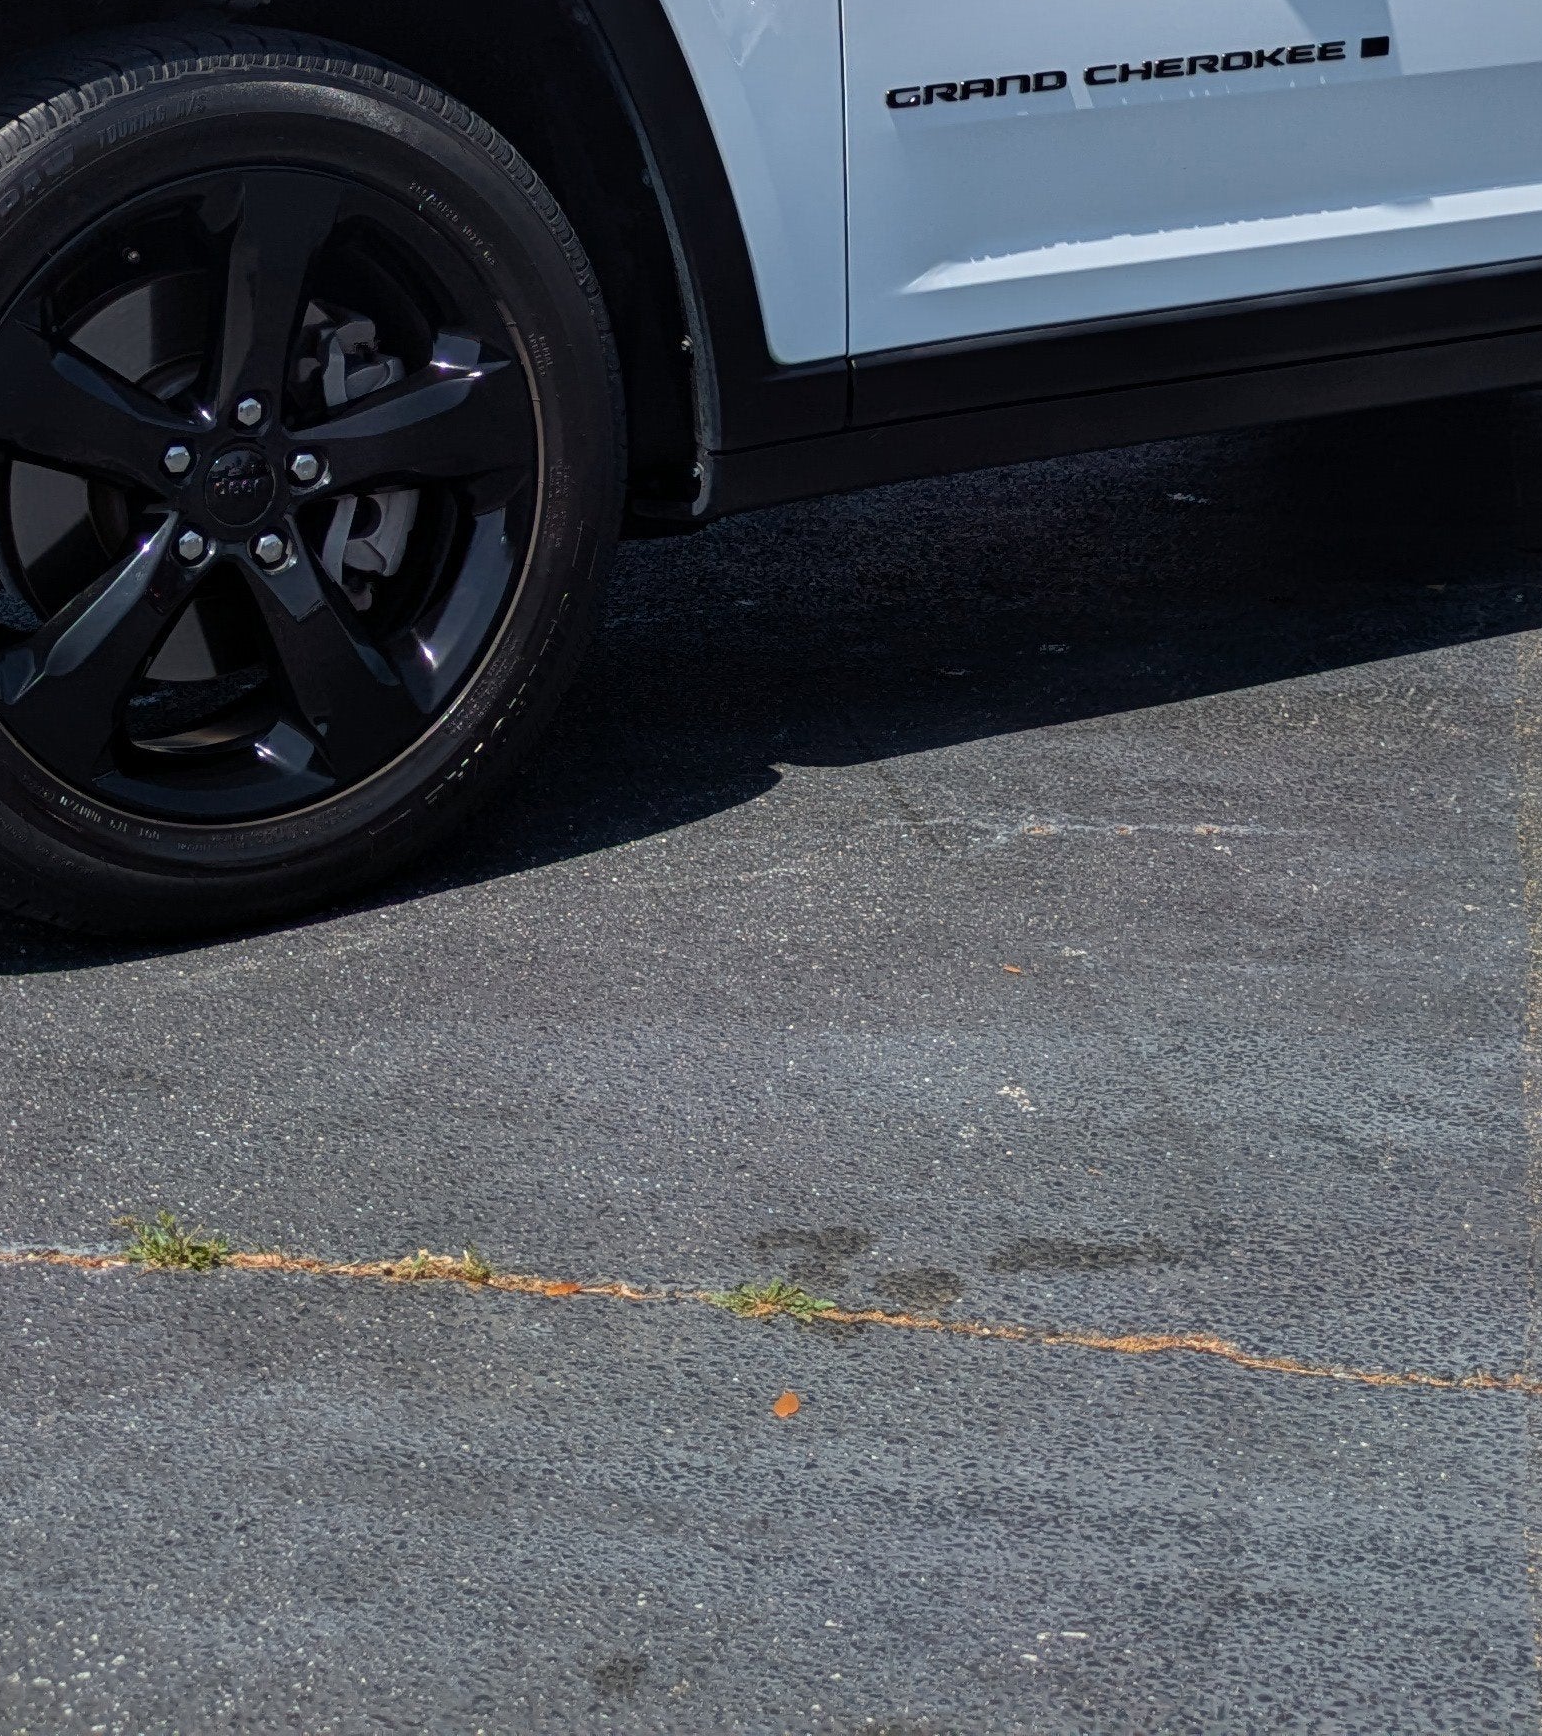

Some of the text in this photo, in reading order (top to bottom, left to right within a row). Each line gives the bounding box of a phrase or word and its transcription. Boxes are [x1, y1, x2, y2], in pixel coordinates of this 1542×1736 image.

[885, 40, 1346, 109] GRAND CHEROKEE
[97, 104, 167, 149] TOURING
